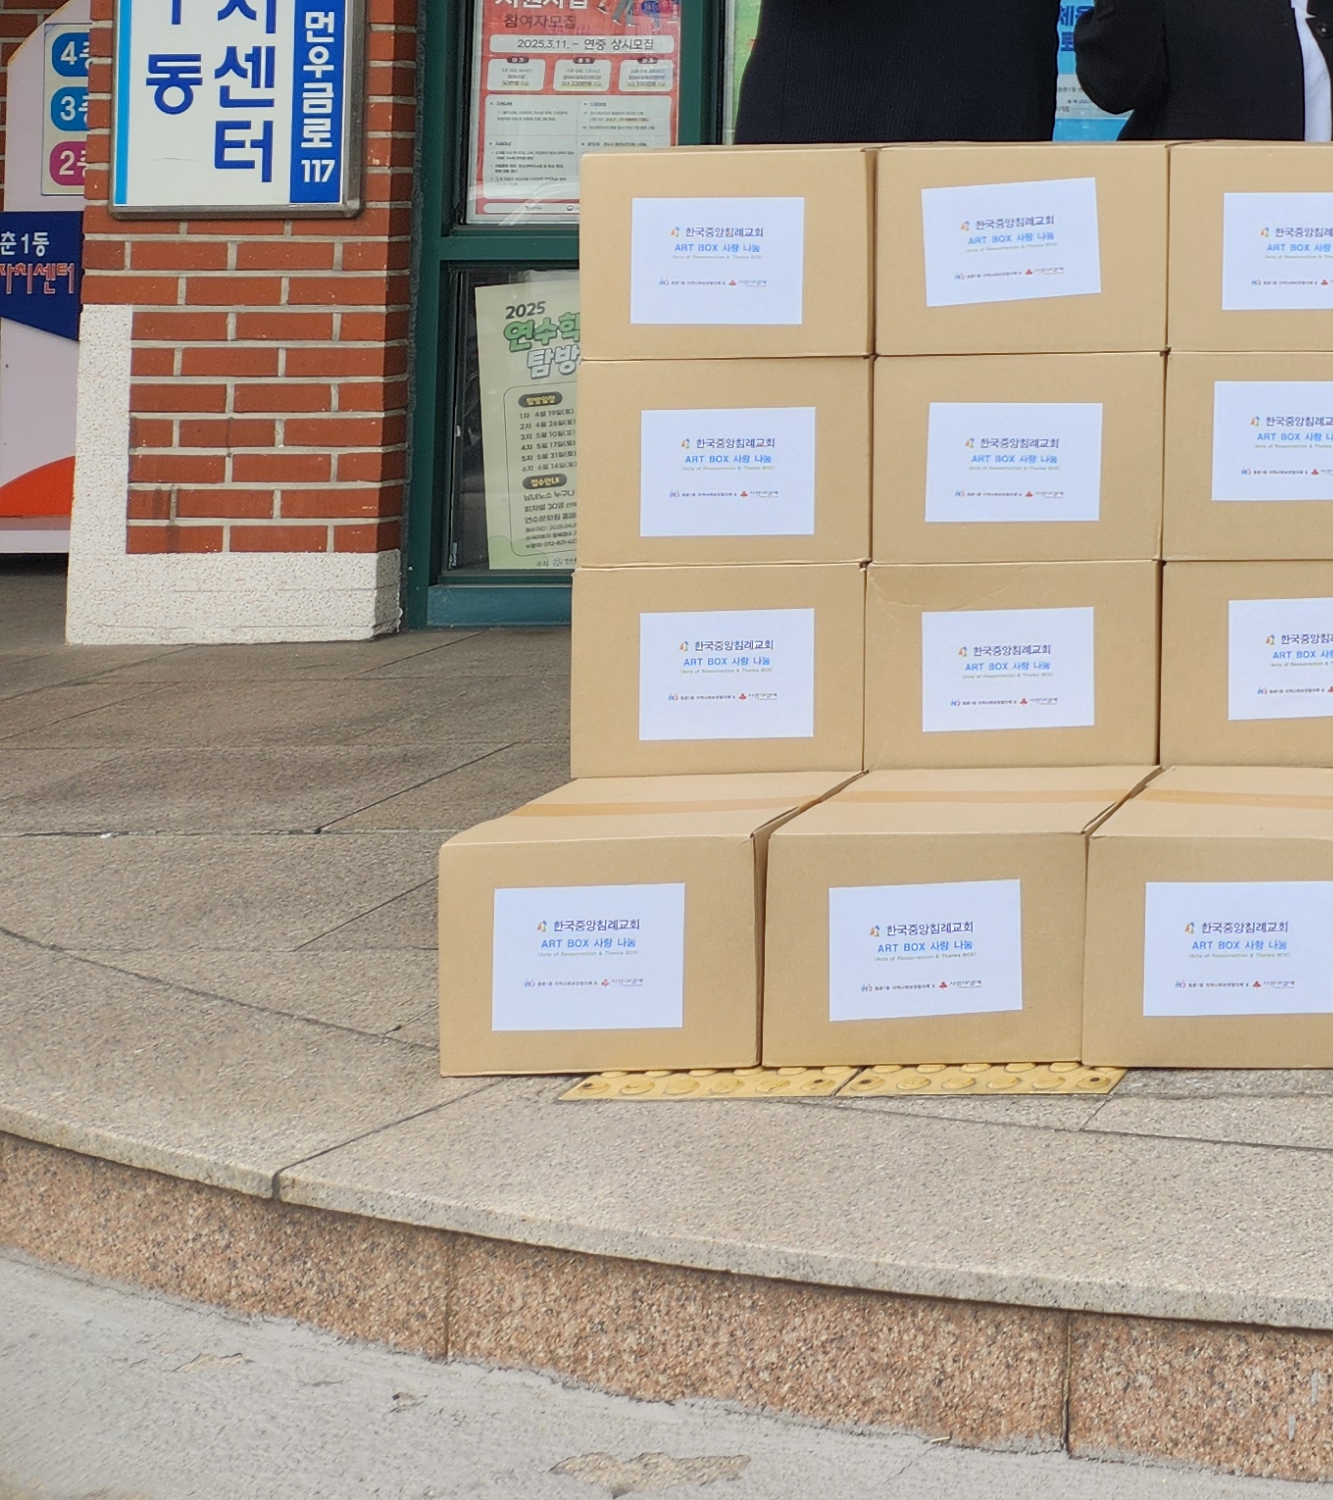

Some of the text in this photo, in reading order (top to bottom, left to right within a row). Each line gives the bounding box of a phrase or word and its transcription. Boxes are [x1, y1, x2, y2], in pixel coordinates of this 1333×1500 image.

[503, 13, 577, 29] 참여자모집
[583, 38, 607, 50] 연중
[611, 38, 654, 50] 상시모집
[301, 12, 335, 148] 먼우금로
[301, 160, 335, 183] 117
[505, 301, 546, 319] 2025
[697, 437, 775, 449] 한국중앙침례교회
[685, 454, 772, 465] ART BOX 사랑 나눔
